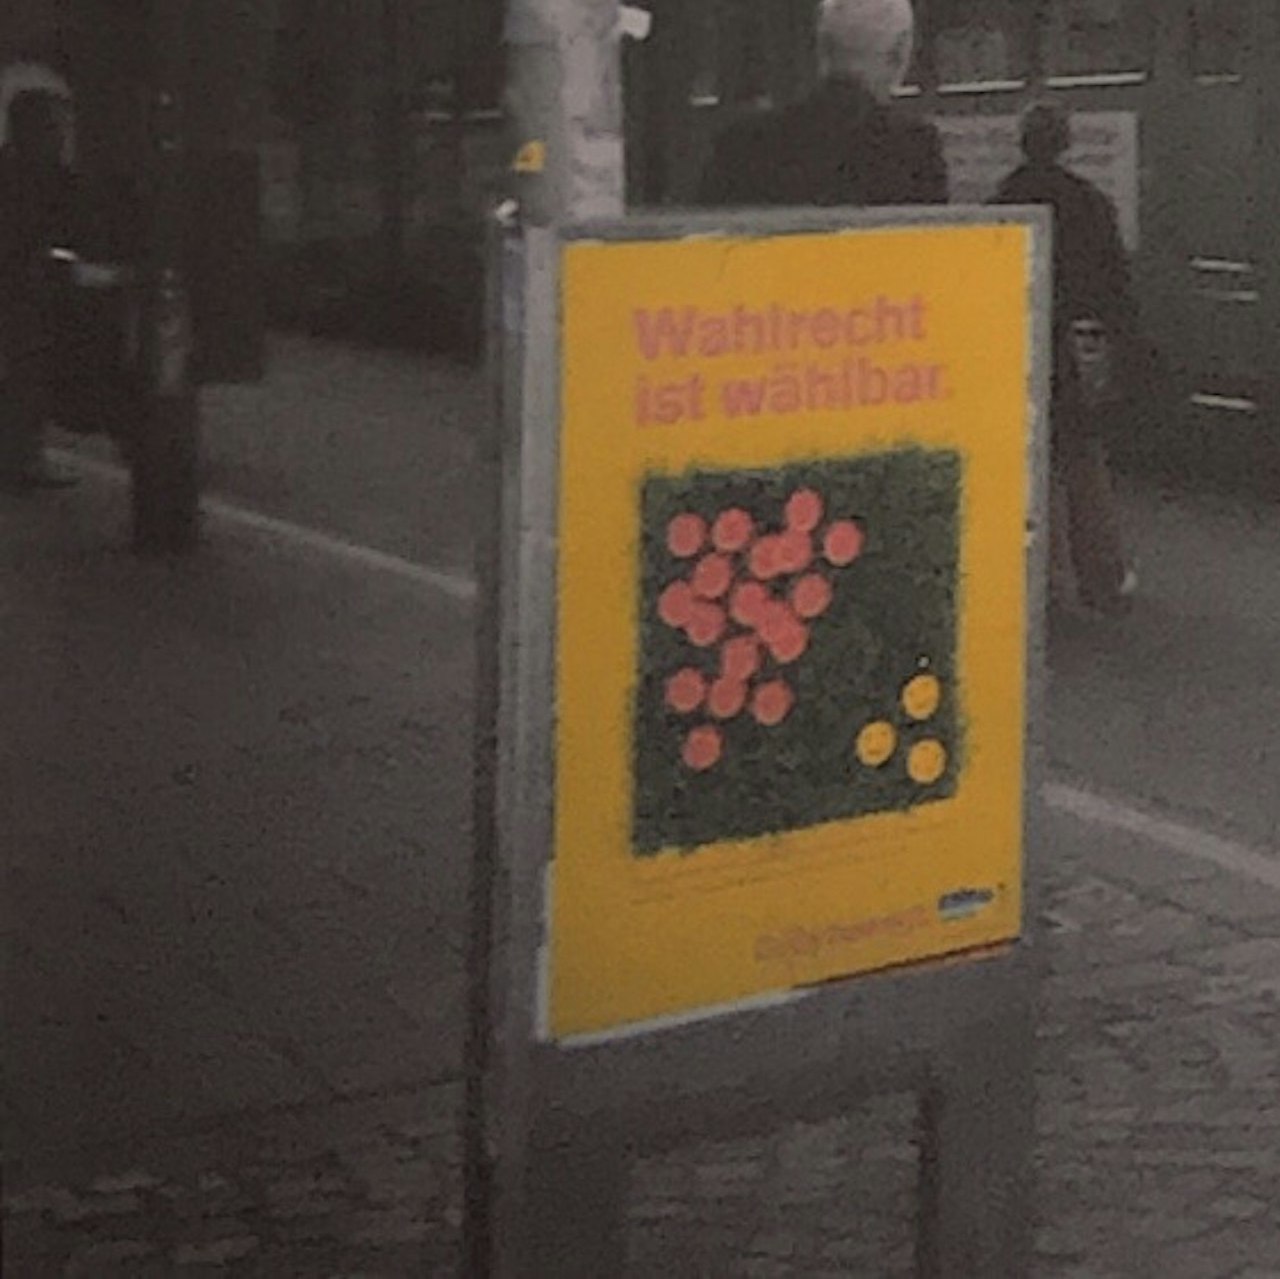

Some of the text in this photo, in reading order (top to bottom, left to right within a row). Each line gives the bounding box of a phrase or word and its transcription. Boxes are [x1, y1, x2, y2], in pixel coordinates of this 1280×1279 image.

[632, 292, 929, 361] Wahlrecht
[633, 354, 957, 427] ist wählbar.
